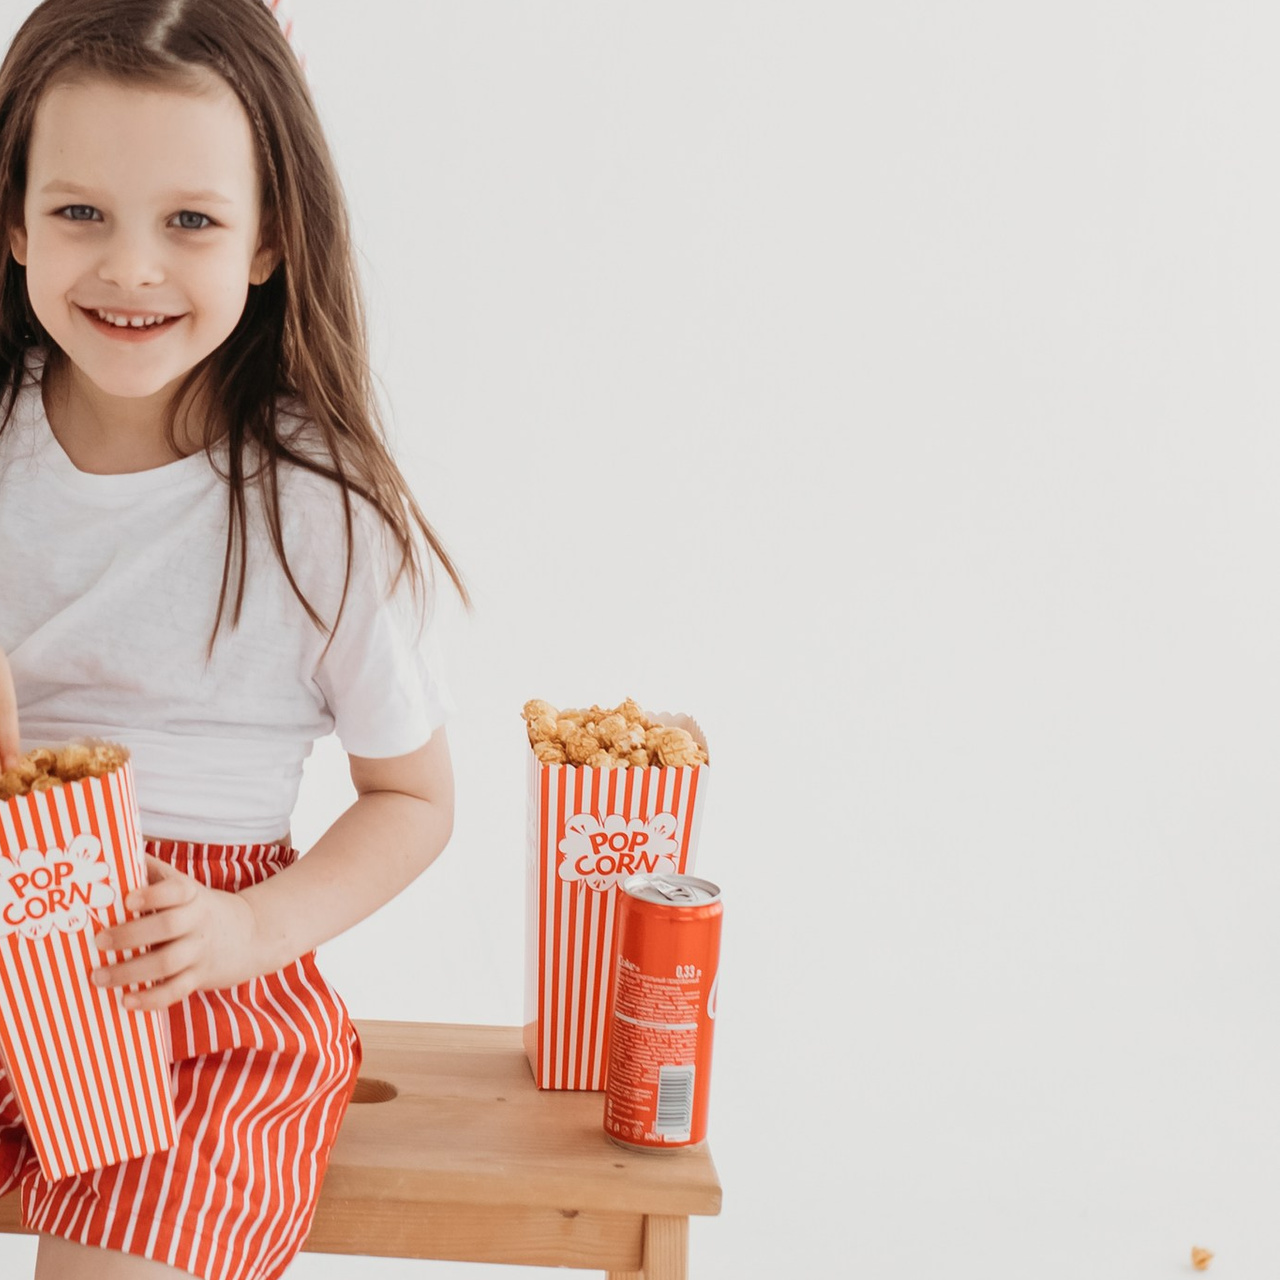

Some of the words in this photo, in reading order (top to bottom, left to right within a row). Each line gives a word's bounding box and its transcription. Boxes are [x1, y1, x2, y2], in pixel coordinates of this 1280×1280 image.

[588, 831, 650, 856] POP
[8, 861, 74, 899] POP
[574, 852, 660, 877] CORN
[2, 883, 92, 926] CORN
